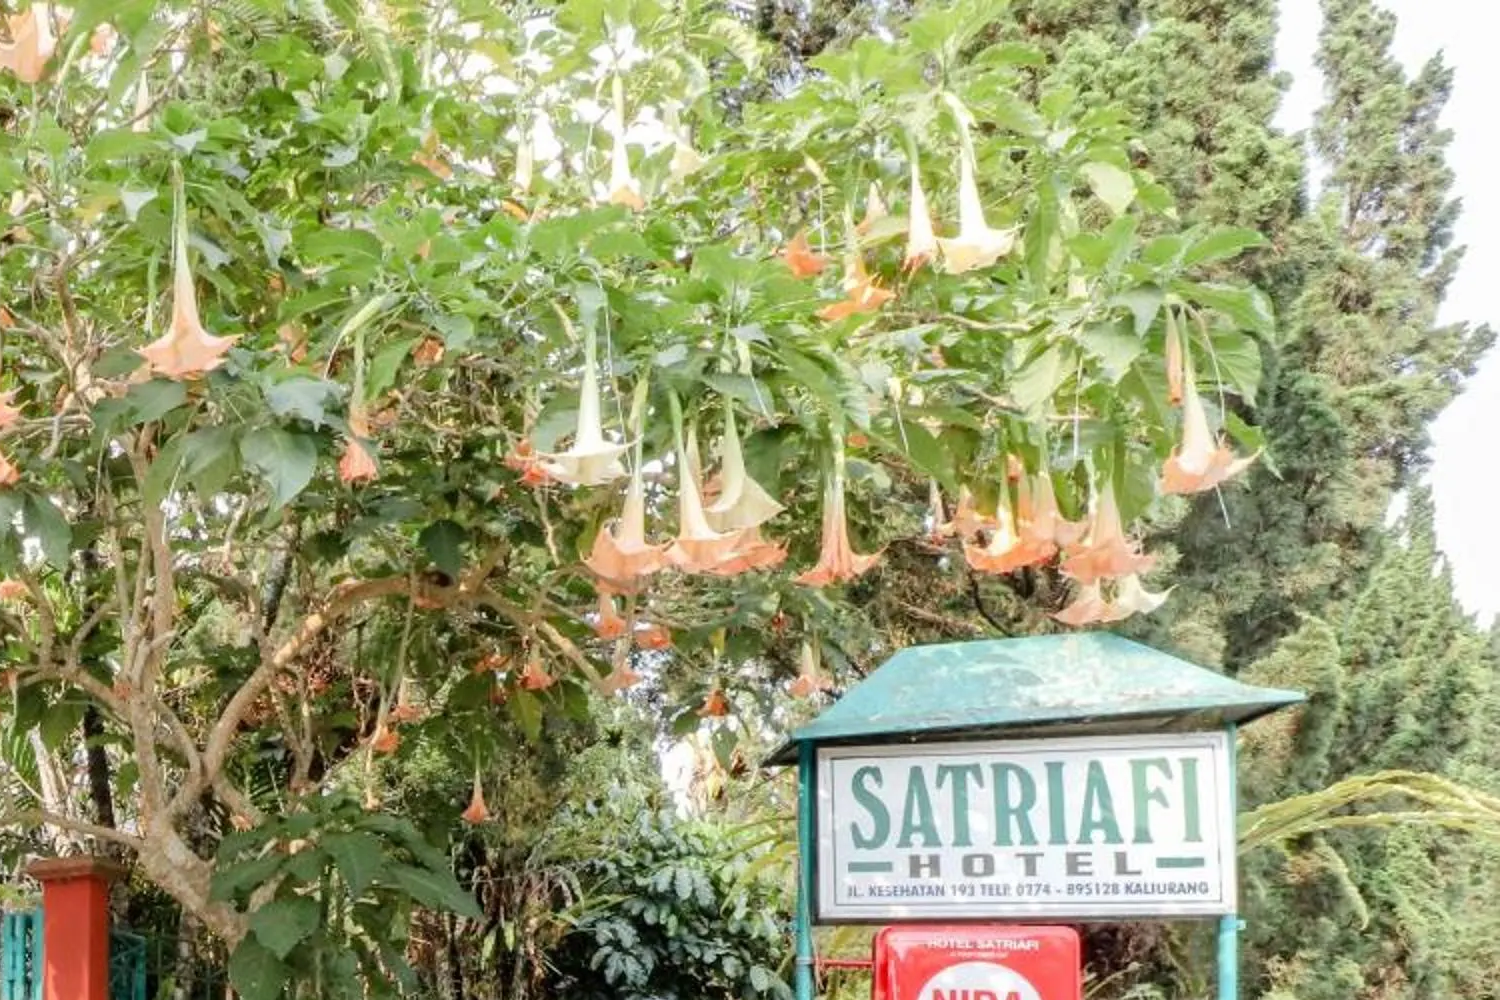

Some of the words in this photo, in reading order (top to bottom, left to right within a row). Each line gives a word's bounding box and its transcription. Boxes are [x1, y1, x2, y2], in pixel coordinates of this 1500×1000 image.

[850, 757, 1204, 850] SATRIAFI
[908, 851, 1142, 878] HOTEL
[847, 884, 864, 897] JL.
[869, 884, 946, 897] KESEHATAN
[952, 883, 975, 897] 193
[1016, 882, 1051, 896] 0774
[1066, 881, 1120, 896] 895128
[1124, 881, 1209, 895] KALIURANG
[927, 938, 972, 949] HOTEL
[977, 938, 1040, 951] SATRIAFI
